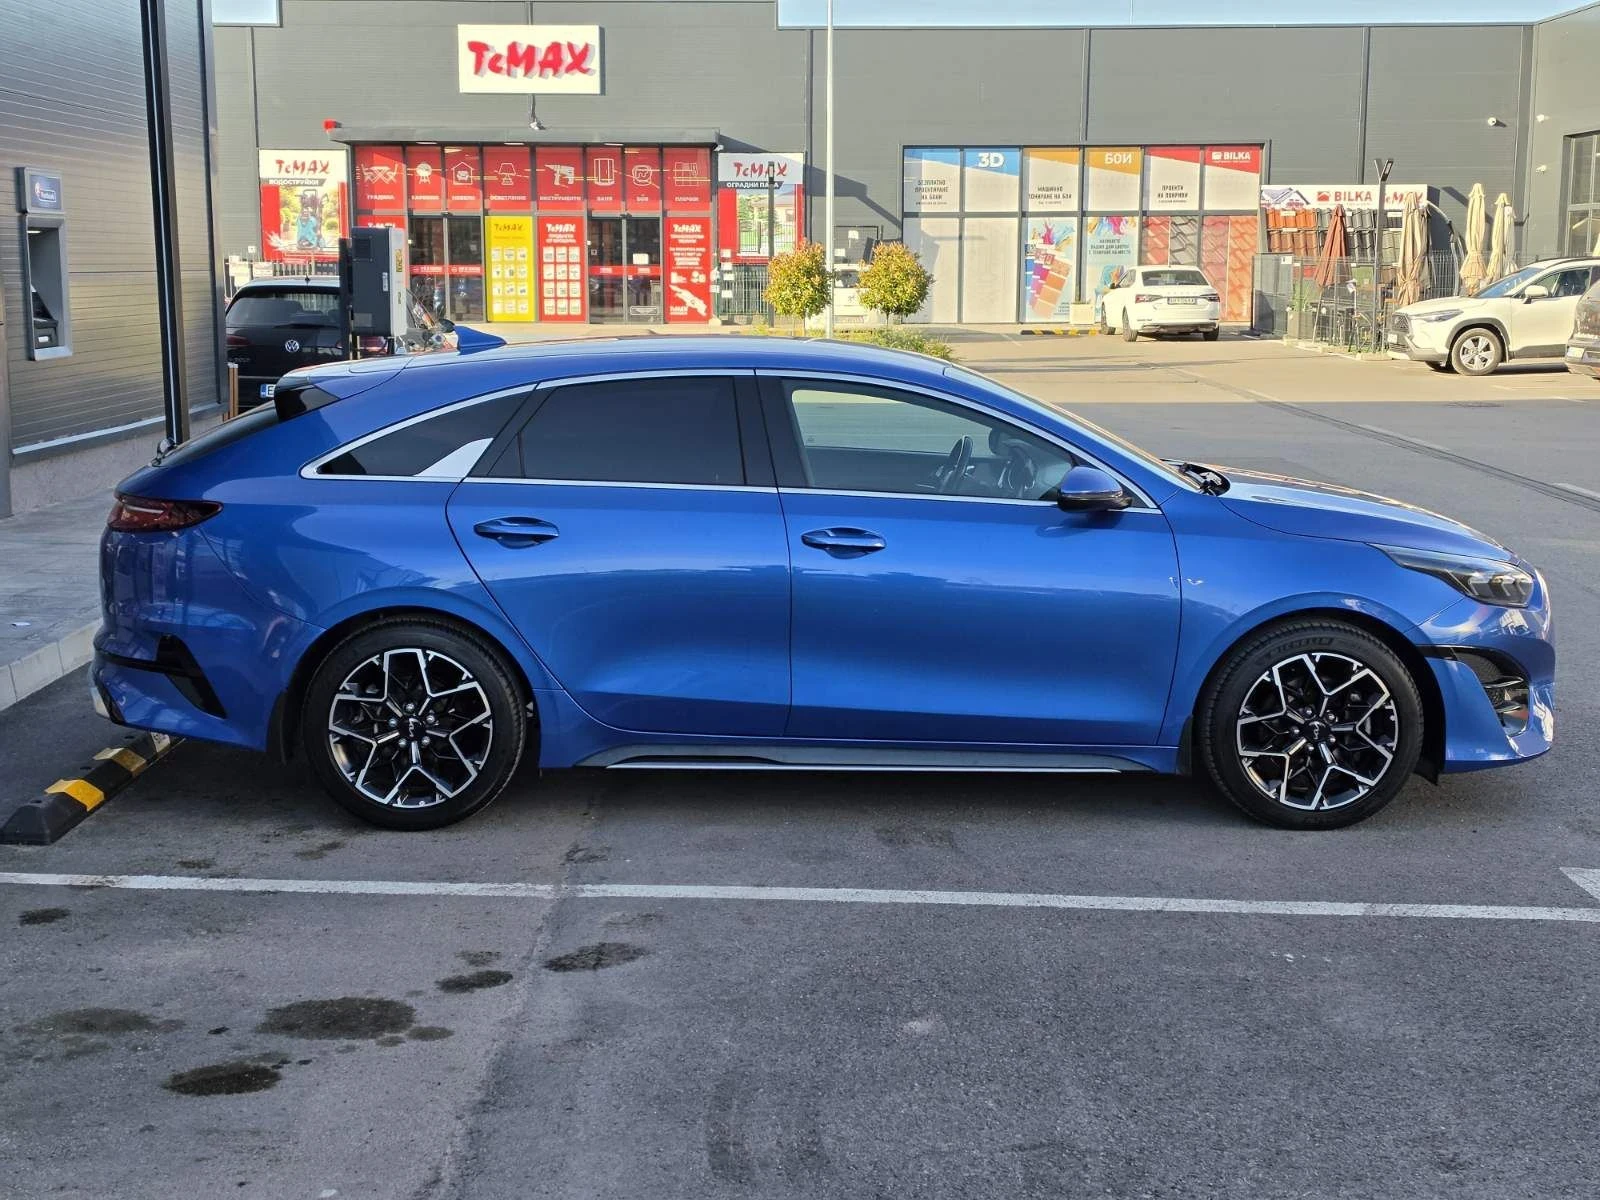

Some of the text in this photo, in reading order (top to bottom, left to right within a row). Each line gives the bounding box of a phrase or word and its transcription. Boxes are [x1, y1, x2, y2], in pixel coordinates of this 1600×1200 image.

[977, 152, 1004, 168] 3D
[1104, 152, 1133, 165] БОИ
[1223, 151, 1251, 160] BILKA
[726, 181, 759, 190] ОГРАДНИ
[1334, 191, 1373, 202] BILKA
